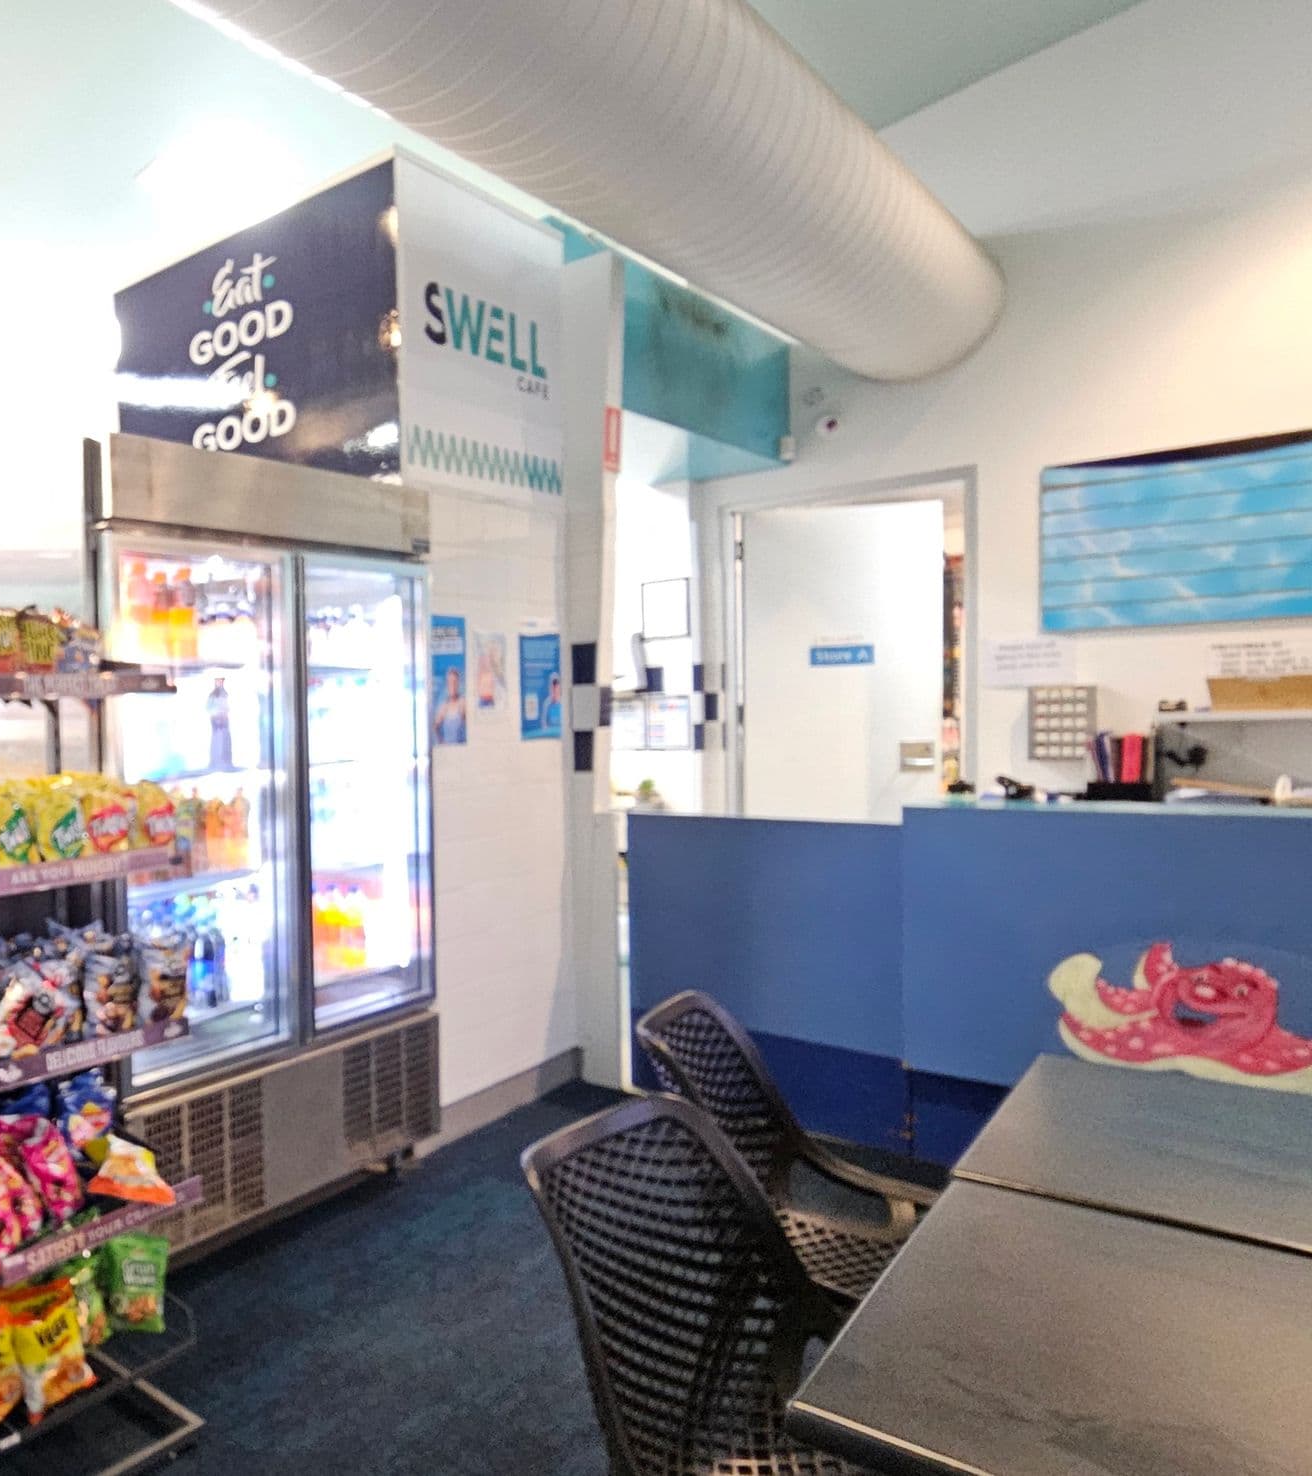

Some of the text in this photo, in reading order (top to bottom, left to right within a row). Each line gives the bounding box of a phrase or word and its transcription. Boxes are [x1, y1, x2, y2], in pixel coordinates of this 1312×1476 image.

[212, 253, 277, 317] Eat
[189, 300, 292, 364] GOOD
[425, 282, 547, 379] SWELL
[193, 400, 296, 451] GOOD
